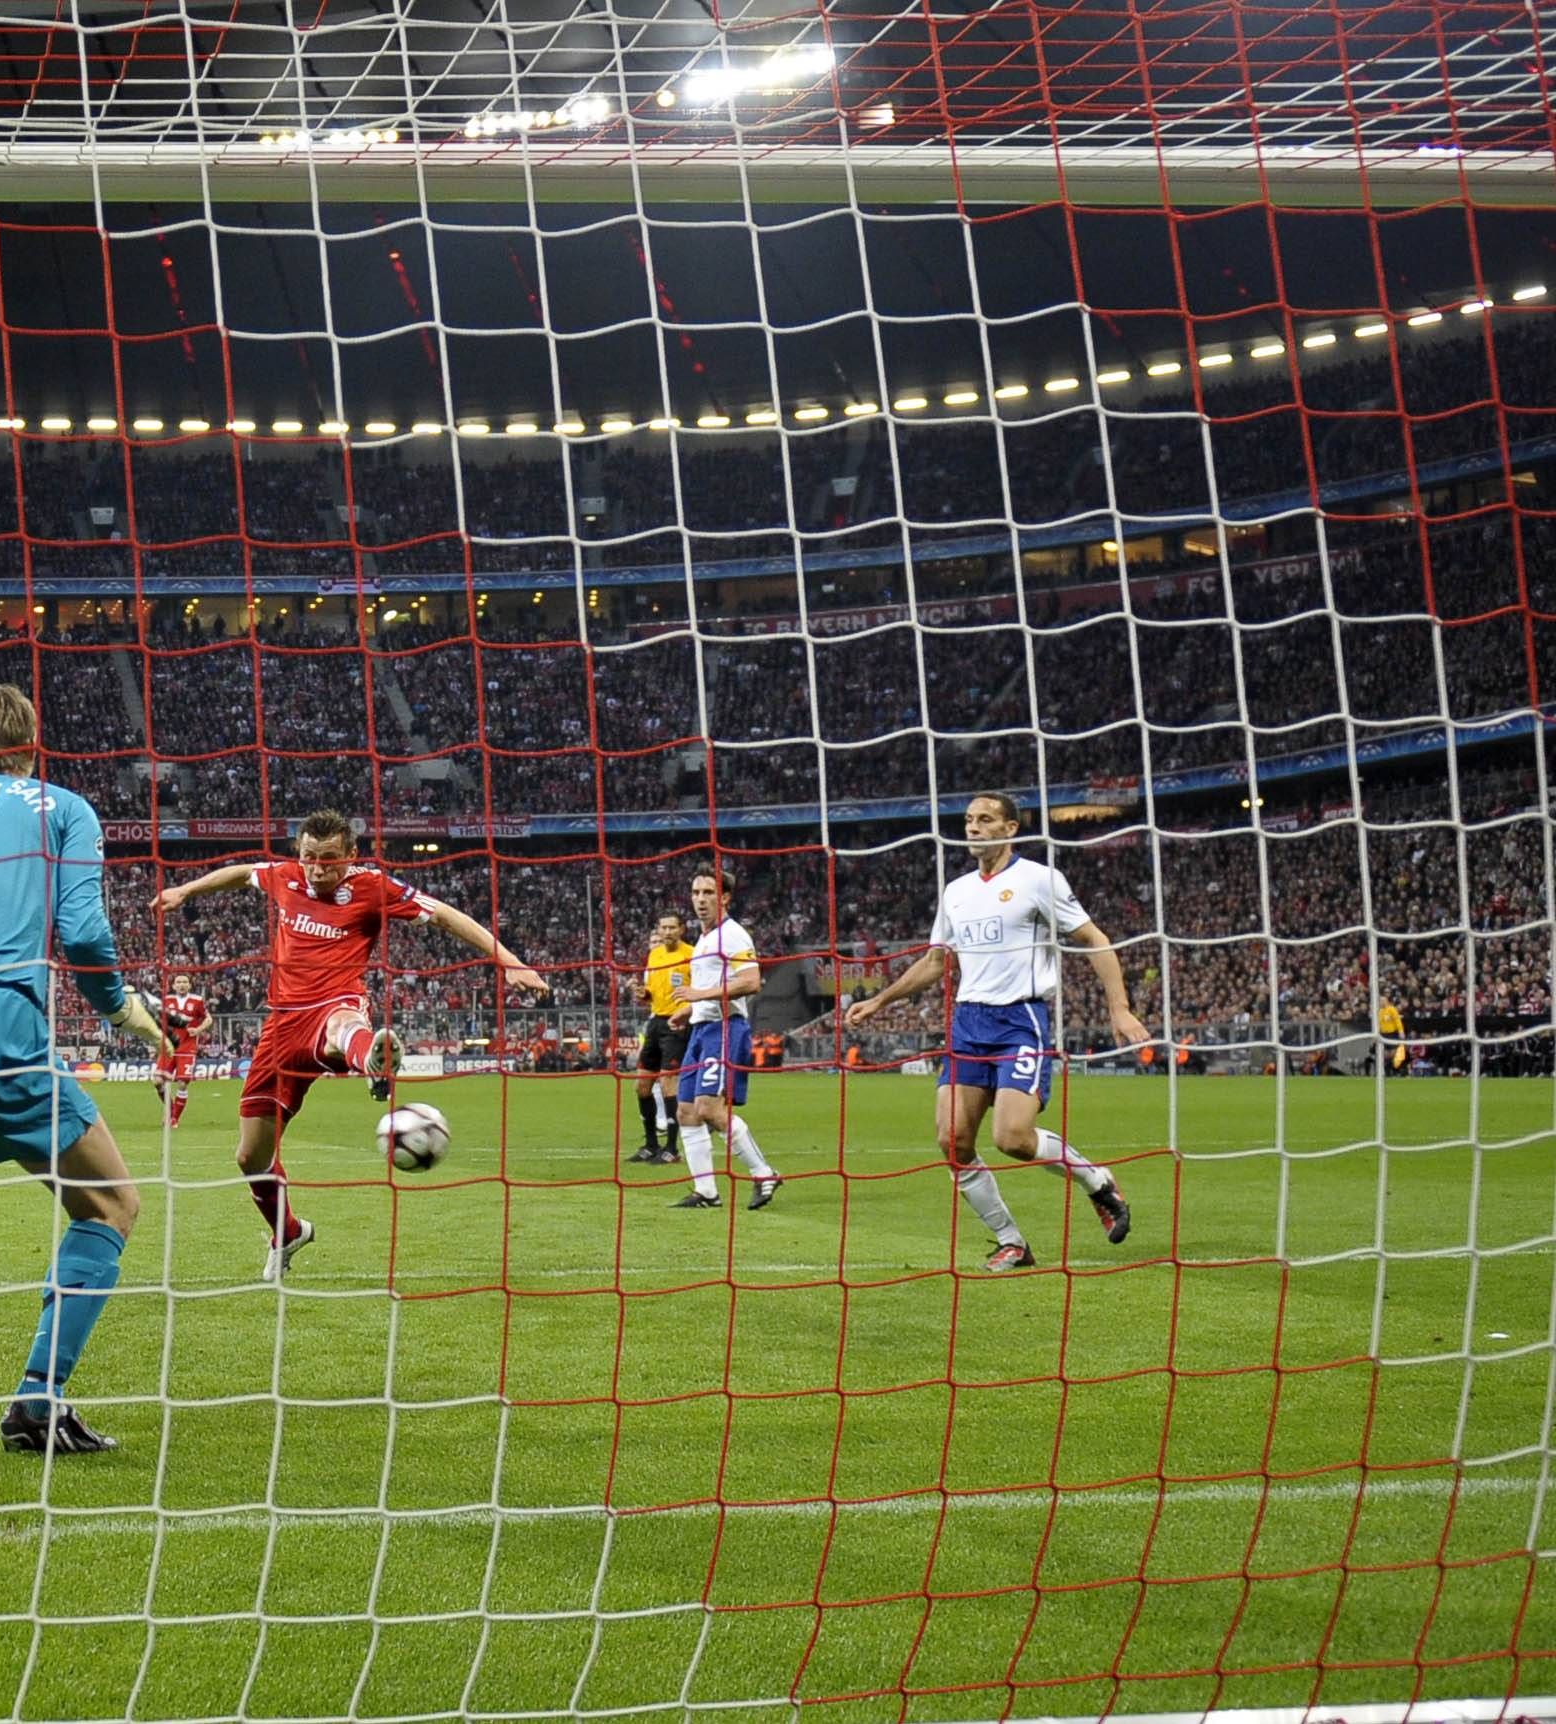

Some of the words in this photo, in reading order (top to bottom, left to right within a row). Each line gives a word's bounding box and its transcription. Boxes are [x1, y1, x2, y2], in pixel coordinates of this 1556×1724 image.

[6, 780, 57, 814] SAR
[961, 920, 999, 942] AIG
[457, 1059, 515, 1073] RESPECT
[703, 1057, 719, 1080] 2
[1015, 1045, 1037, 1075] 5
